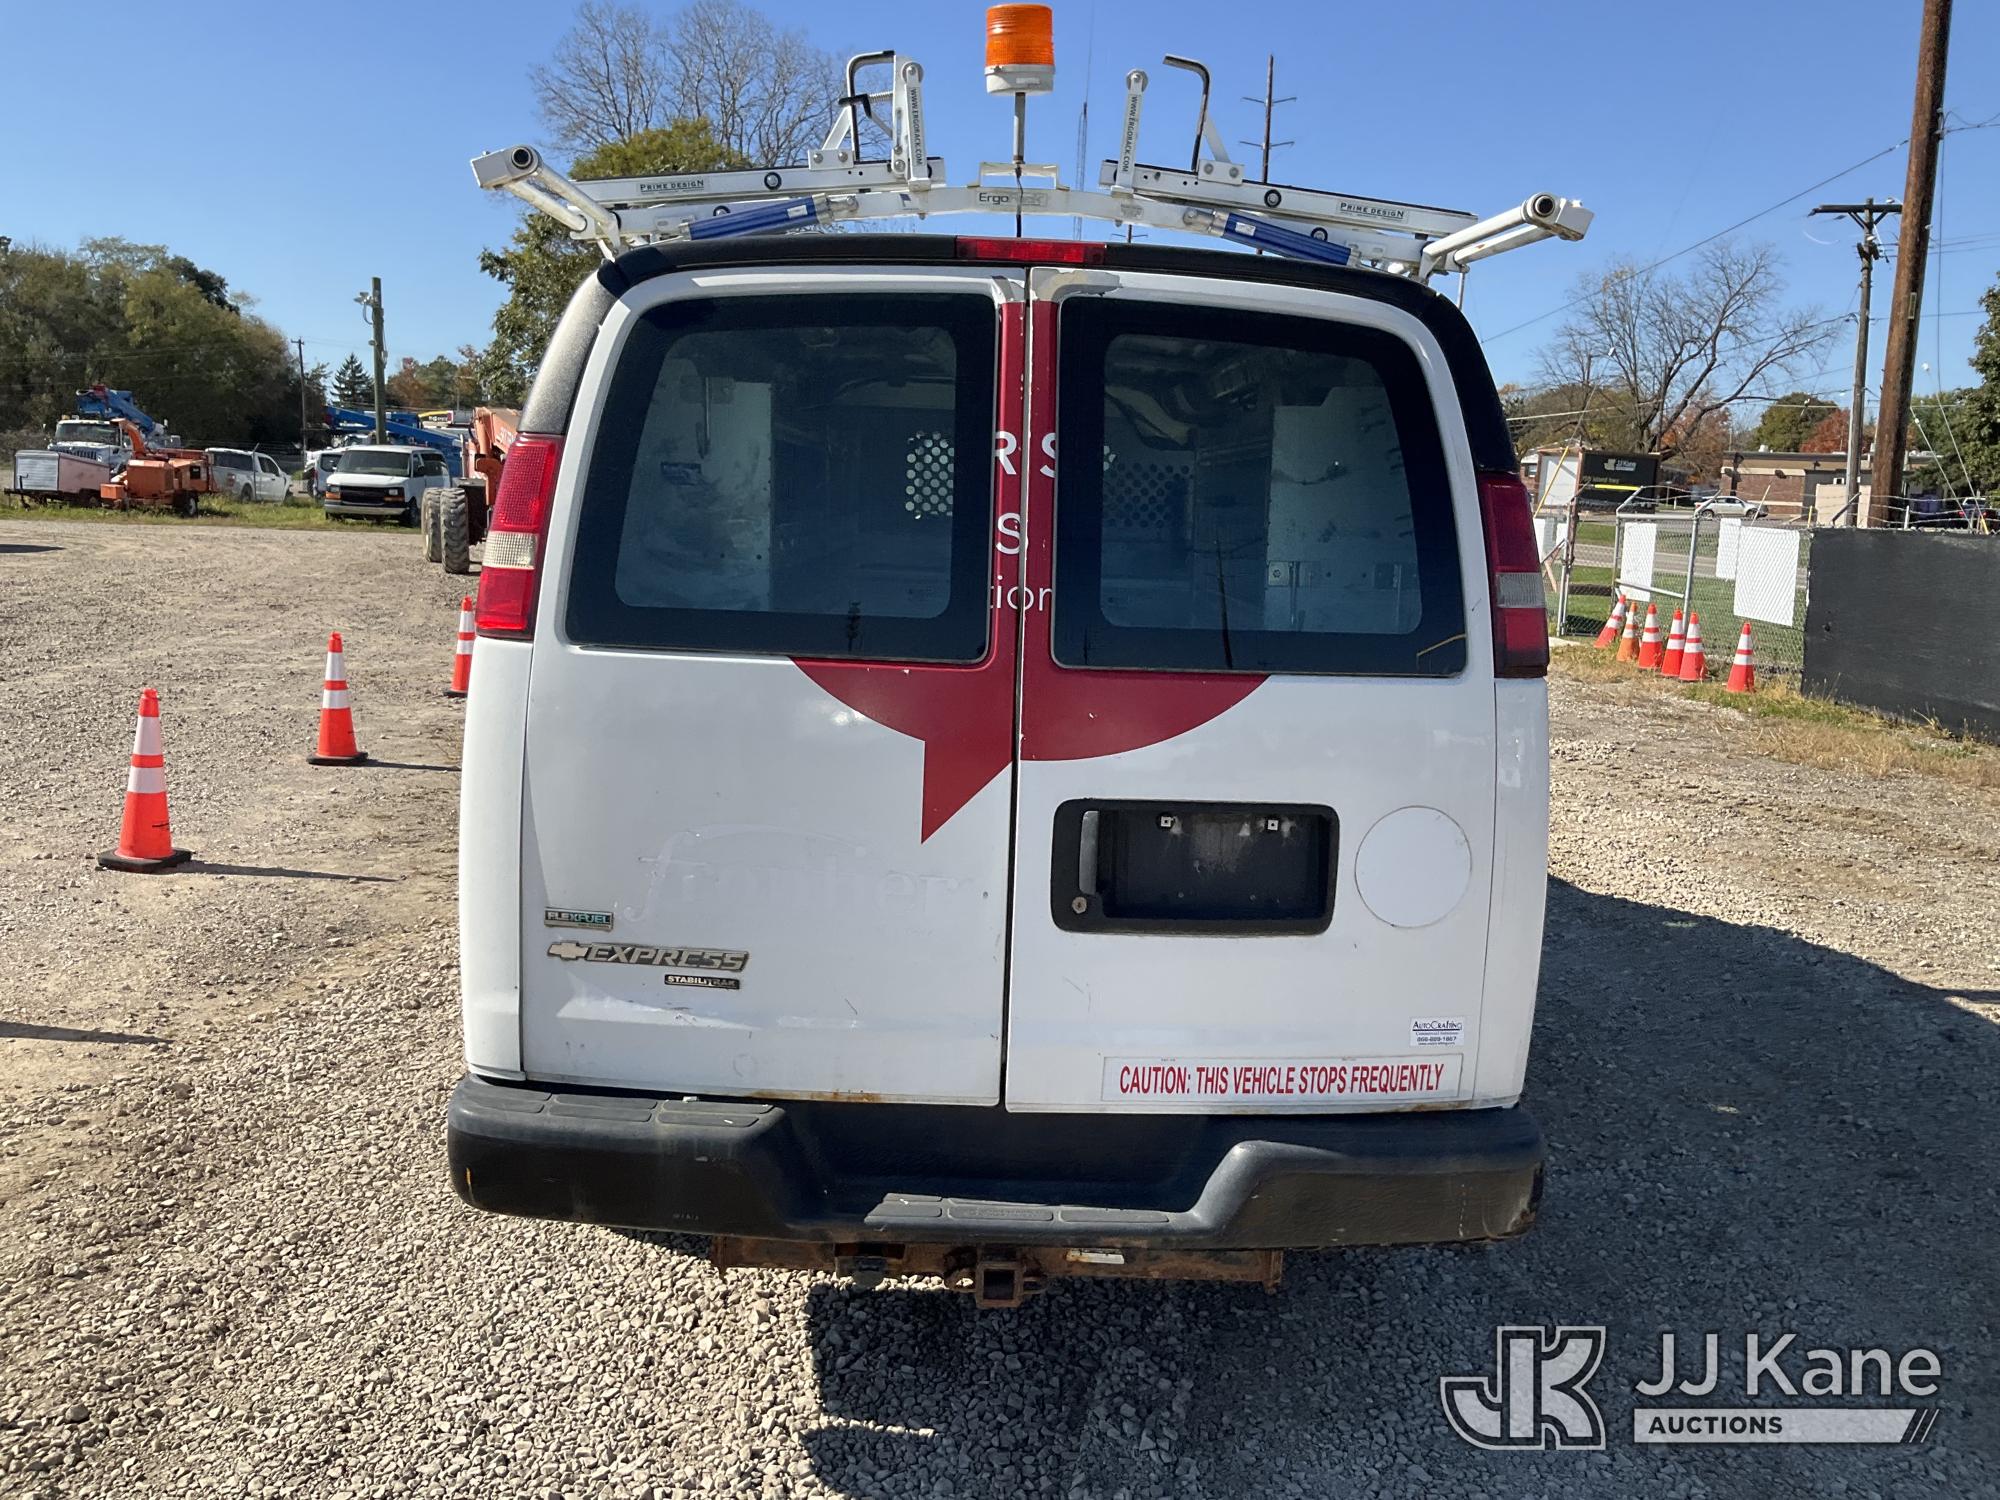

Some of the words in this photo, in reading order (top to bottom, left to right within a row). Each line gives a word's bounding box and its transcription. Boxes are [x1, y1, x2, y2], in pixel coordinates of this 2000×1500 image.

[587, 943, 749, 971] EXPRESS
[1119, 1065, 1192, 1094] CAUTION:
[1196, 1066, 1229, 1094] THIS
[1233, 1066, 1296, 1095] VEHICLE
[1299, 1065, 1348, 1094] STOPS
[1350, 1063, 1445, 1094] FREQUENTLY
